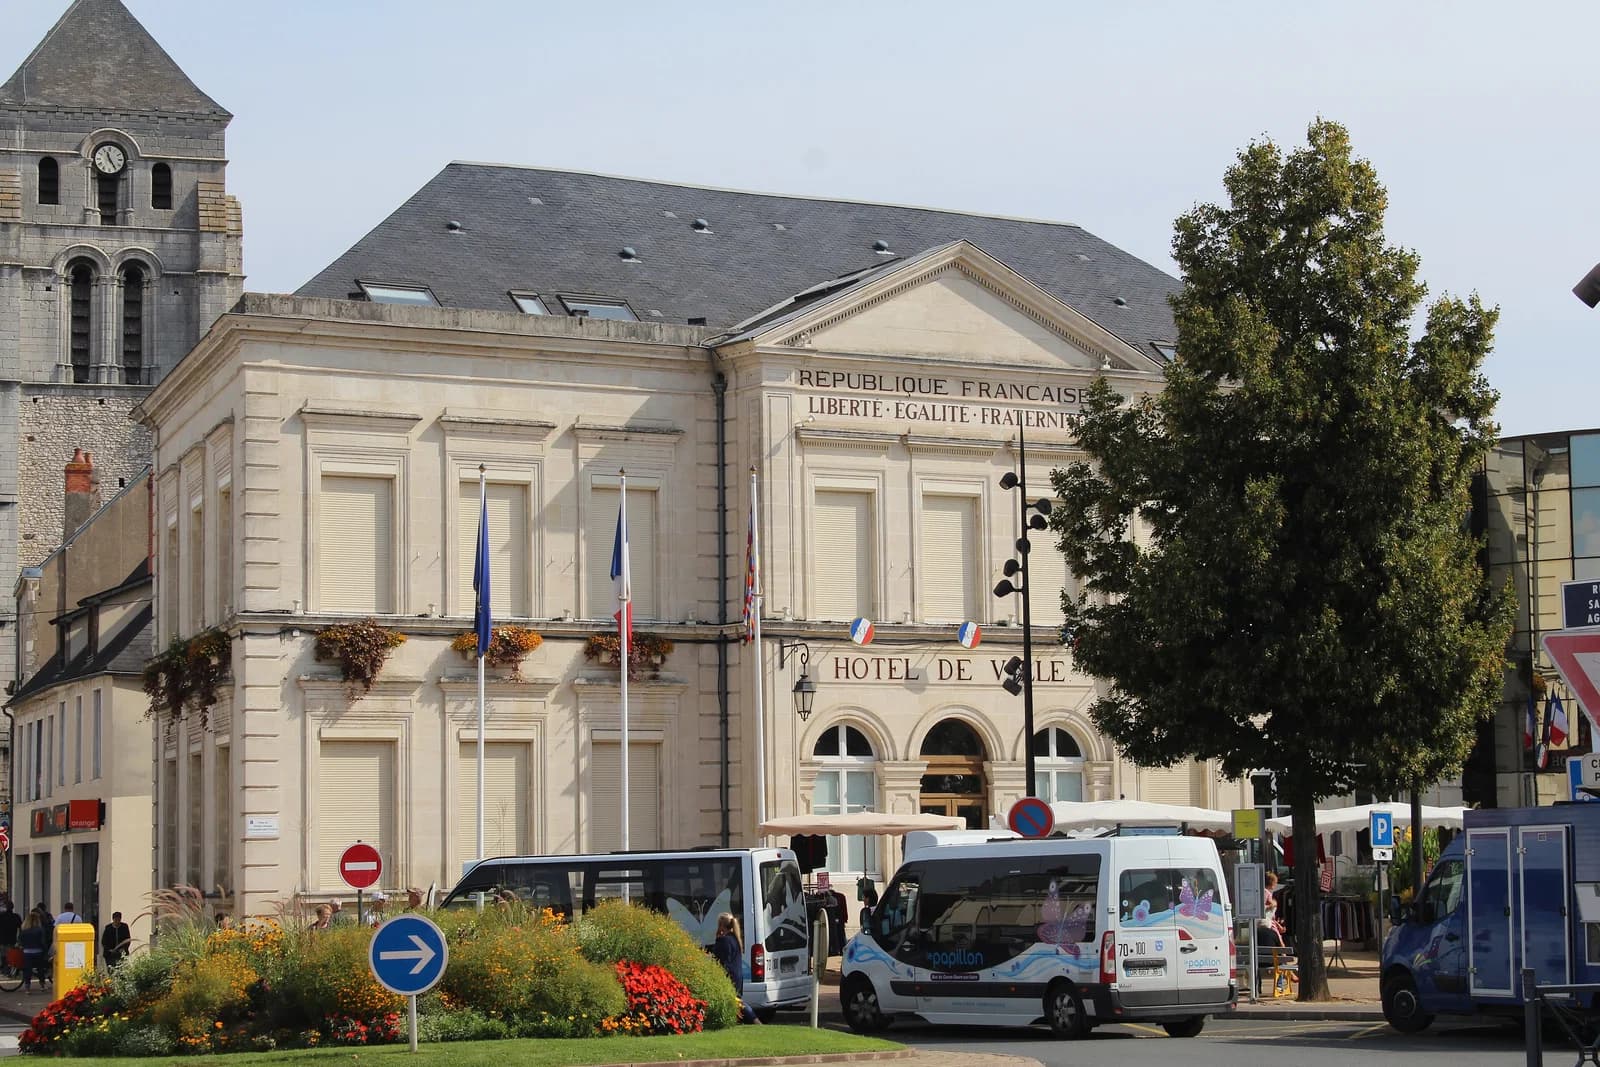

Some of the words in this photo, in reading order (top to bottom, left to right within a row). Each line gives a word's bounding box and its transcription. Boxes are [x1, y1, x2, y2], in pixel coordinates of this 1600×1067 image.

[834, 657, 920, 681] HOTEL
[938, 658, 973, 681] DE
[71, 819, 96, 827] orange
[1377, 817, 1388, 840] P
[932, 949, 984, 969] papillon
[1117, 943, 1129, 957] 70
